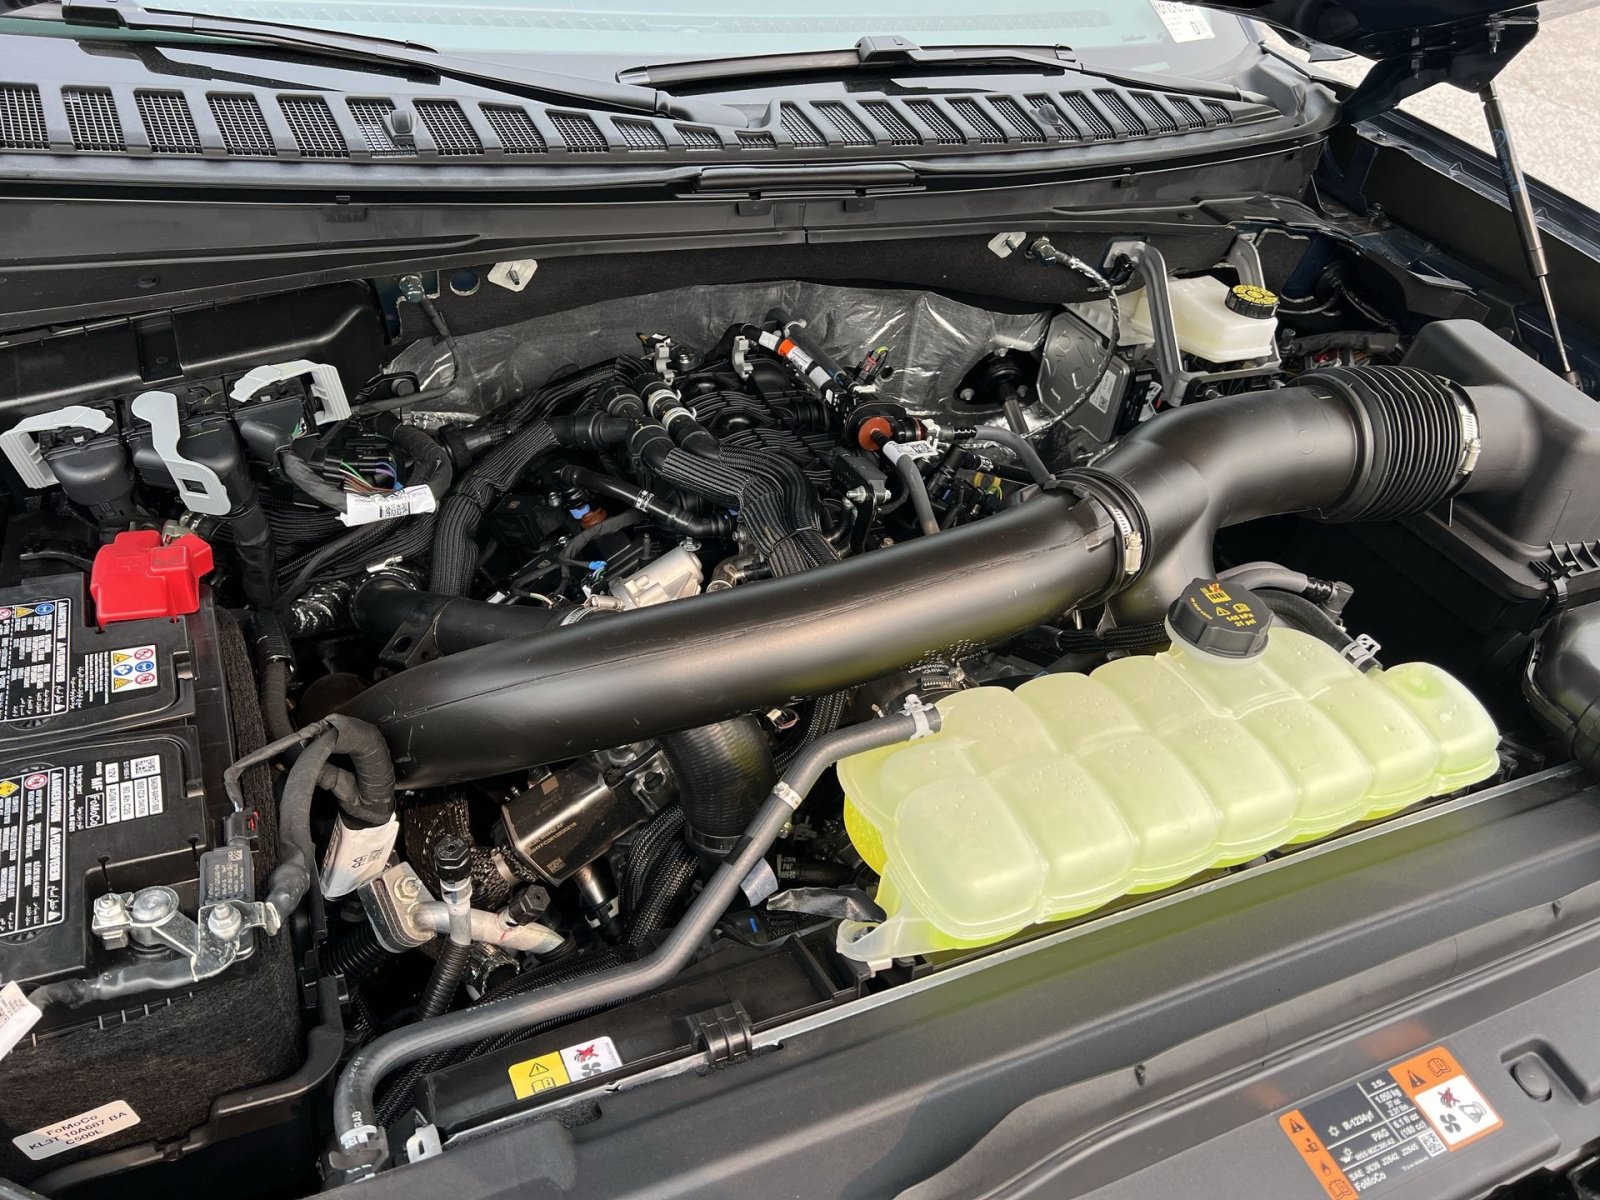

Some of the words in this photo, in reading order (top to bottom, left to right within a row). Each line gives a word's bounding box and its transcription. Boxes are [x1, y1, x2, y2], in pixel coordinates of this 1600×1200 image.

[107, 767, 117, 778] 12V
[91, 777, 103, 791] MF
[90, 794, 100, 827] FoMoCo
[1392, 1088, 1402, 1098] kg
[46, 1115, 98, 1135] FoMoCo
[352, 1111, 363, 1128] RAD
[1341, 1110, 1375, 1131] R-1234yf
[29, 1136, 60, 1150] KL3T
[64, 1120, 106, 1137] 10A687
[109, 1111, 128, 1121] BA
[1371, 1128, 1390, 1142] PAG
[1348, 1169, 1365, 1181] SAE
[1354, 1171, 1387, 1192] FoMoCo
